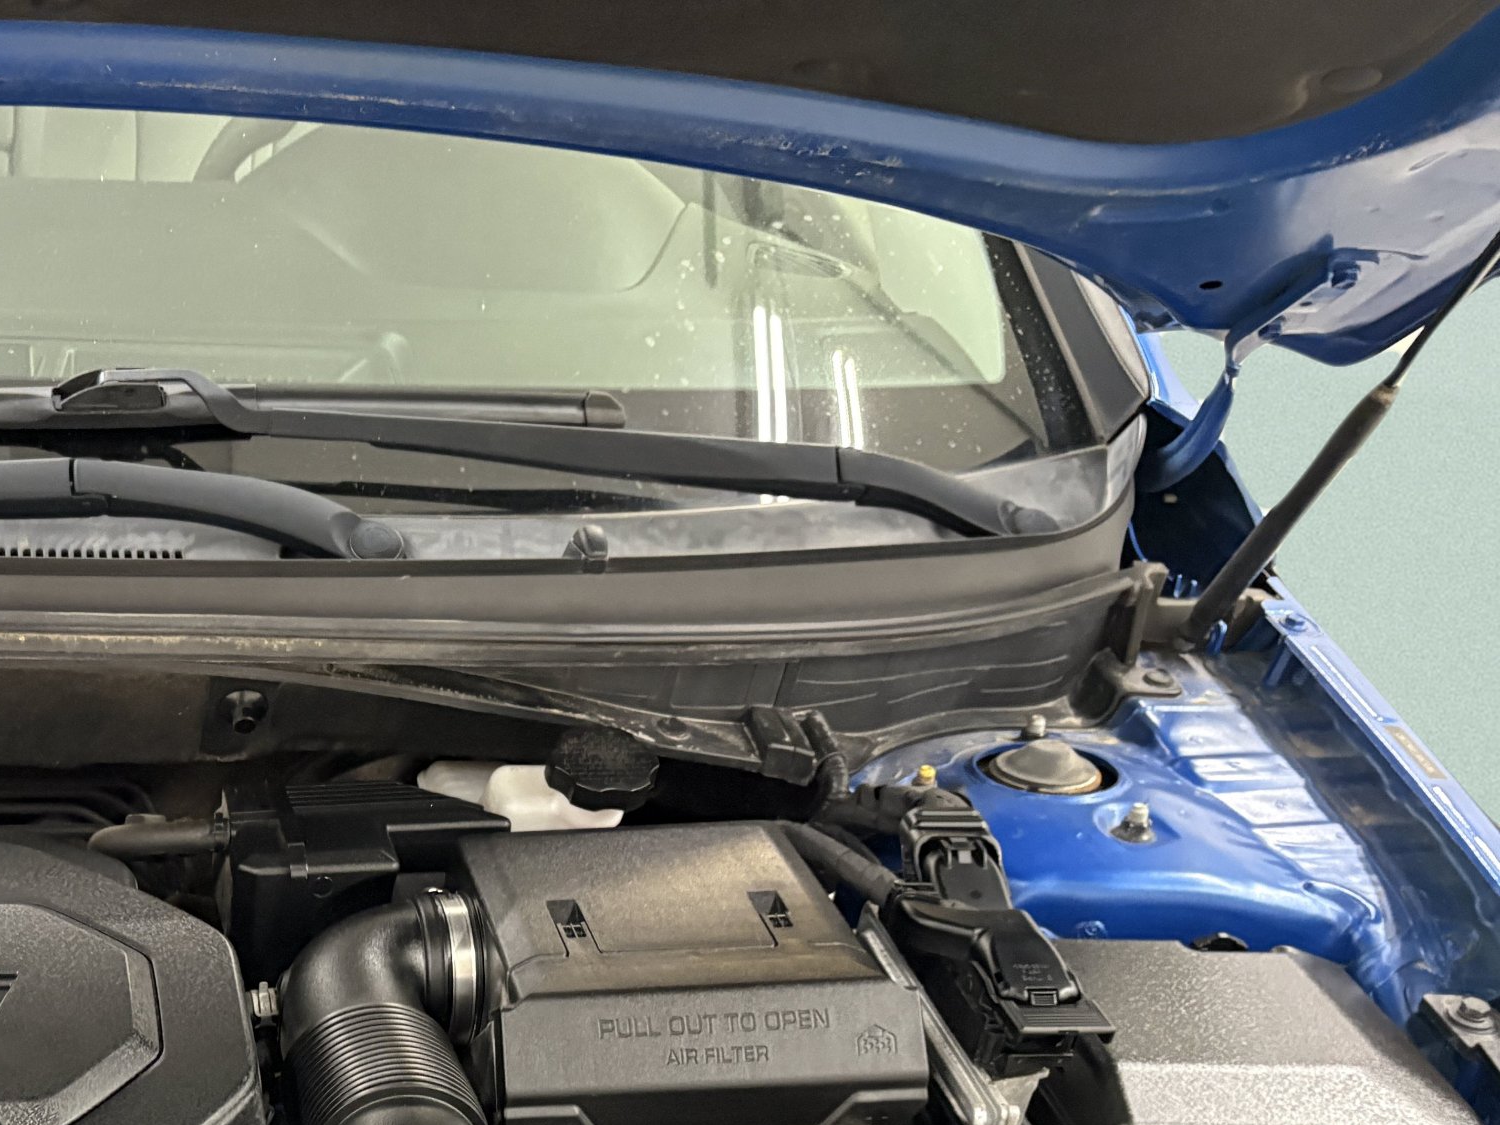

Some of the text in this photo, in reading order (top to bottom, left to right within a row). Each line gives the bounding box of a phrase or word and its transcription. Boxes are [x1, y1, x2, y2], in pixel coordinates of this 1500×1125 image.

[599, 1008, 831, 1039] PULL OUT TO OPEN
[666, 1045, 769, 1066] AIR FILTER
